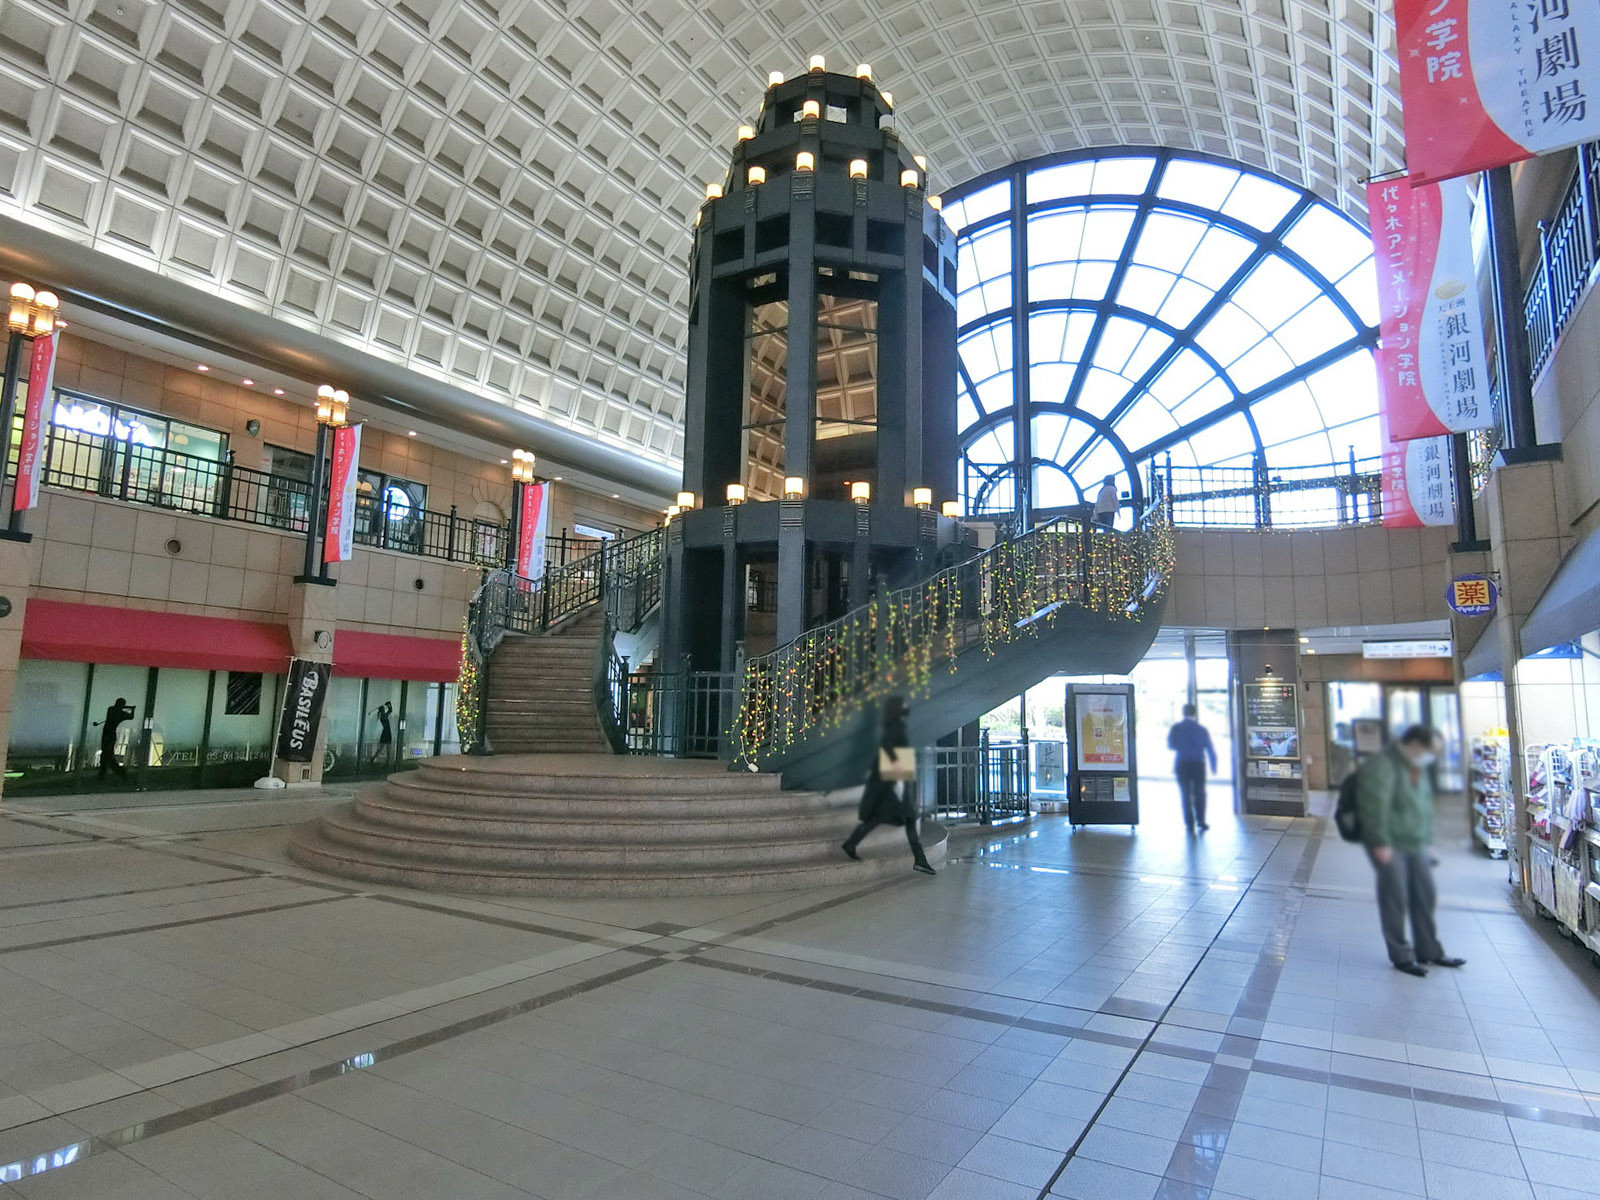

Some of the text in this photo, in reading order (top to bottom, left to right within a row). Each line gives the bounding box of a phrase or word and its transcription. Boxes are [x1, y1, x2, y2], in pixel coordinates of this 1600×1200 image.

[1518, 68, 1535, 138] THEATRE
[1381, 186, 1416, 386] 代々木アニメーション学院
[1446, 312, 1477, 418] 銀河劇場
[1456, 581, 1486, 605] 薬
